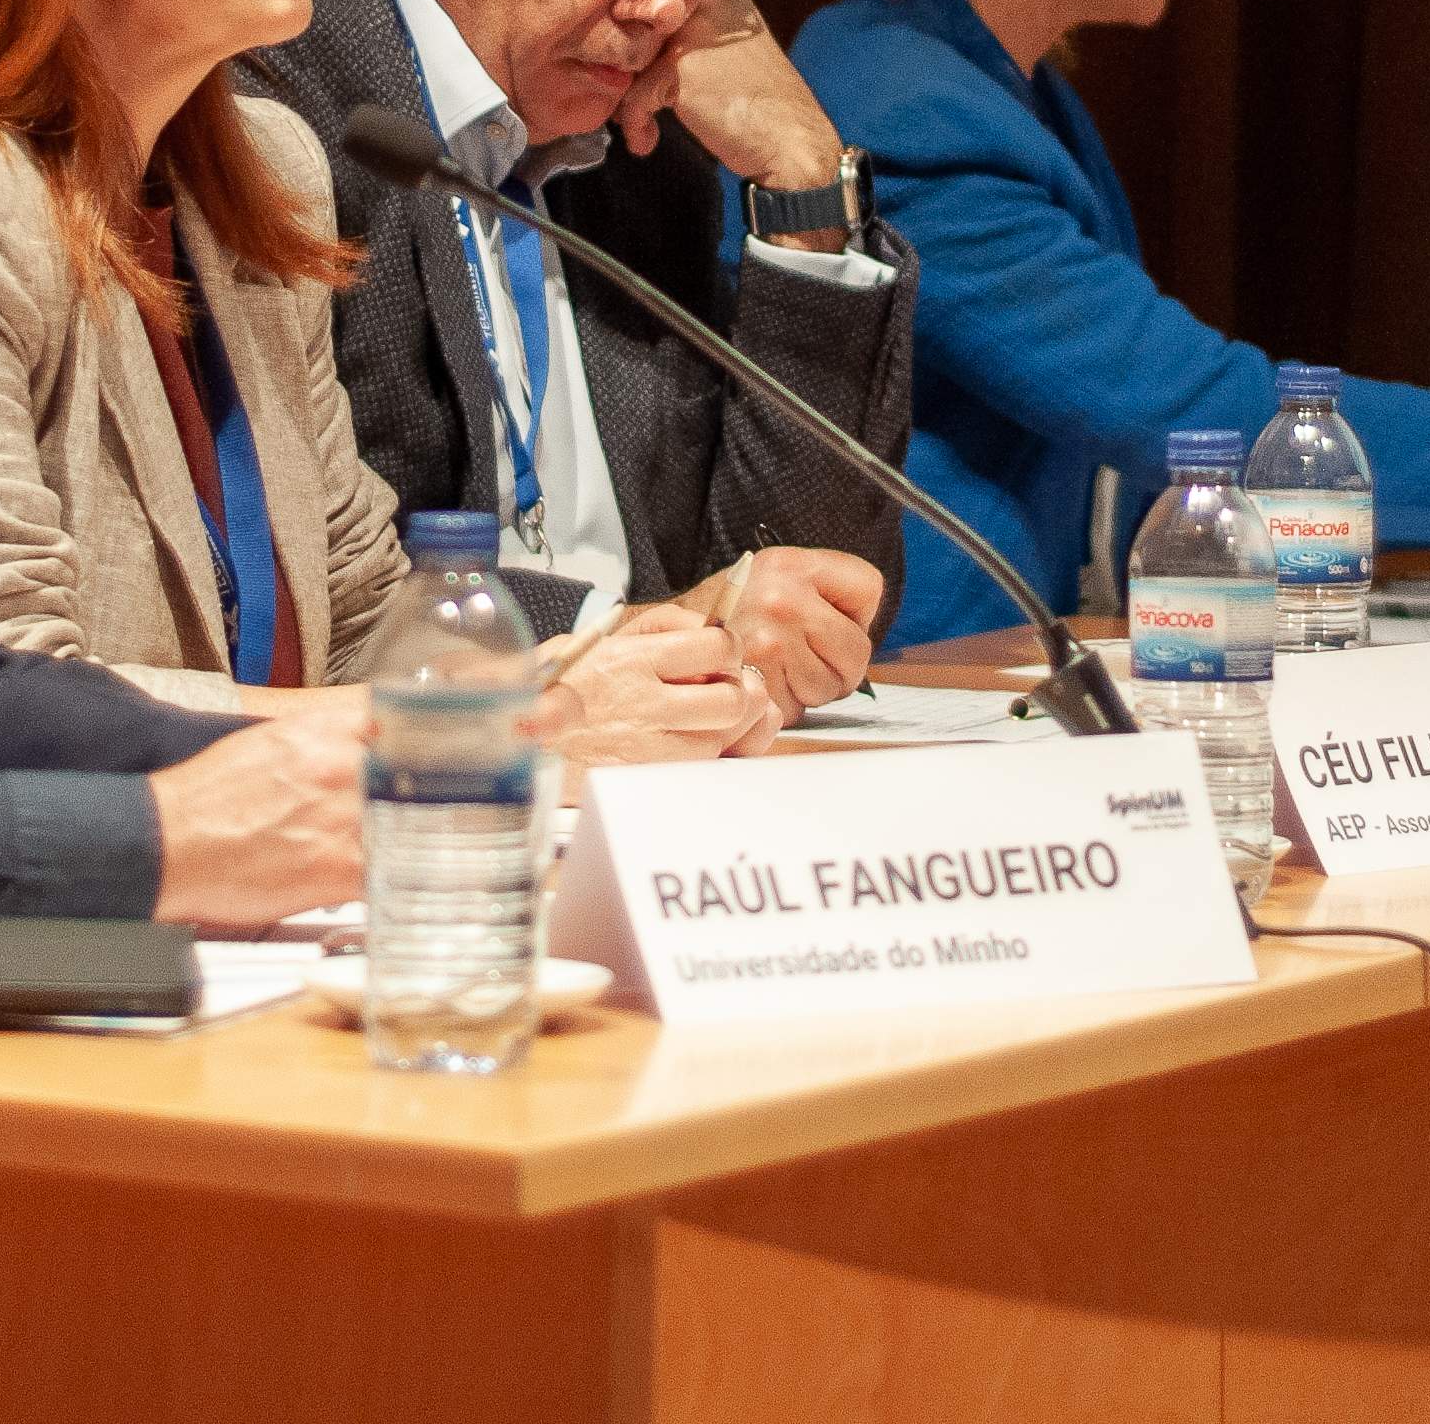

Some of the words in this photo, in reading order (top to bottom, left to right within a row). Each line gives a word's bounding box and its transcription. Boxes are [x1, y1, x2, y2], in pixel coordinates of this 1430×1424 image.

[1269, 517, 1349, 536] Penacova
[1298, 731, 1373, 789] CÉU
[1326, 813, 1367, 843] AEP
[651, 852, 801, 920] RAÚL
[813, 839, 1121, 910] FANGUEIRO
[675, 937, 880, 983] Universidade
[888, 937, 928, 971] do
[936, 930, 1029, 968] Minho
